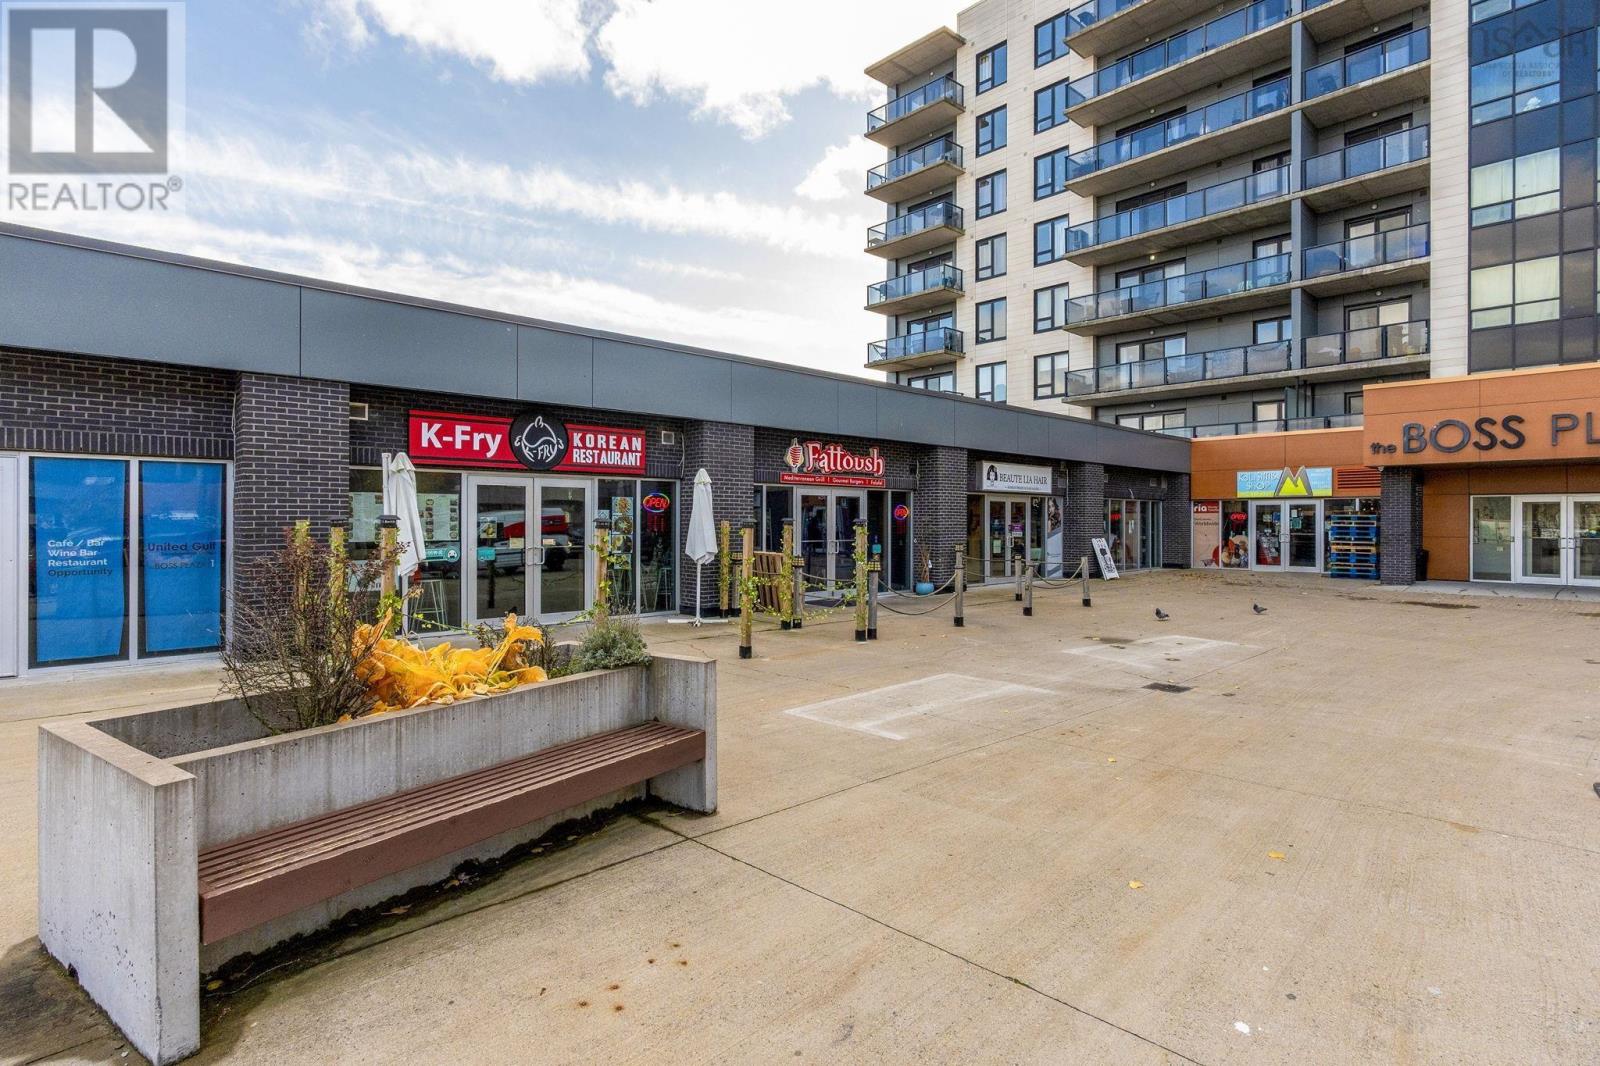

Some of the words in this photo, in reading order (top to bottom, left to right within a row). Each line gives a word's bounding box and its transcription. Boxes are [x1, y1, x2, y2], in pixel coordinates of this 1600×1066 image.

[421, 422, 502, 458] K-Fry
[1371, 442, 1397, 455] the
[1402, 415, 1526, 454] BOSS
[573, 433, 642, 451] KOREAN
[525, 444, 556, 461] K-FRY
[573, 450, 642, 466] RESTAURANT
[806, 442, 885, 475] Fattoush
[1033, 475, 1048, 485] HAIR
[645, 497, 668, 508] OPEN
[86, 539, 105, 547] Bar
[147, 541, 188, 551] United
[191, 541, 217, 551] Gulf
[47, 549, 78, 557] Wine
[79, 549, 98, 557] Bar
[47, 558, 109, 567] Restaurant
[47, 567, 113, 578] Opportunity
